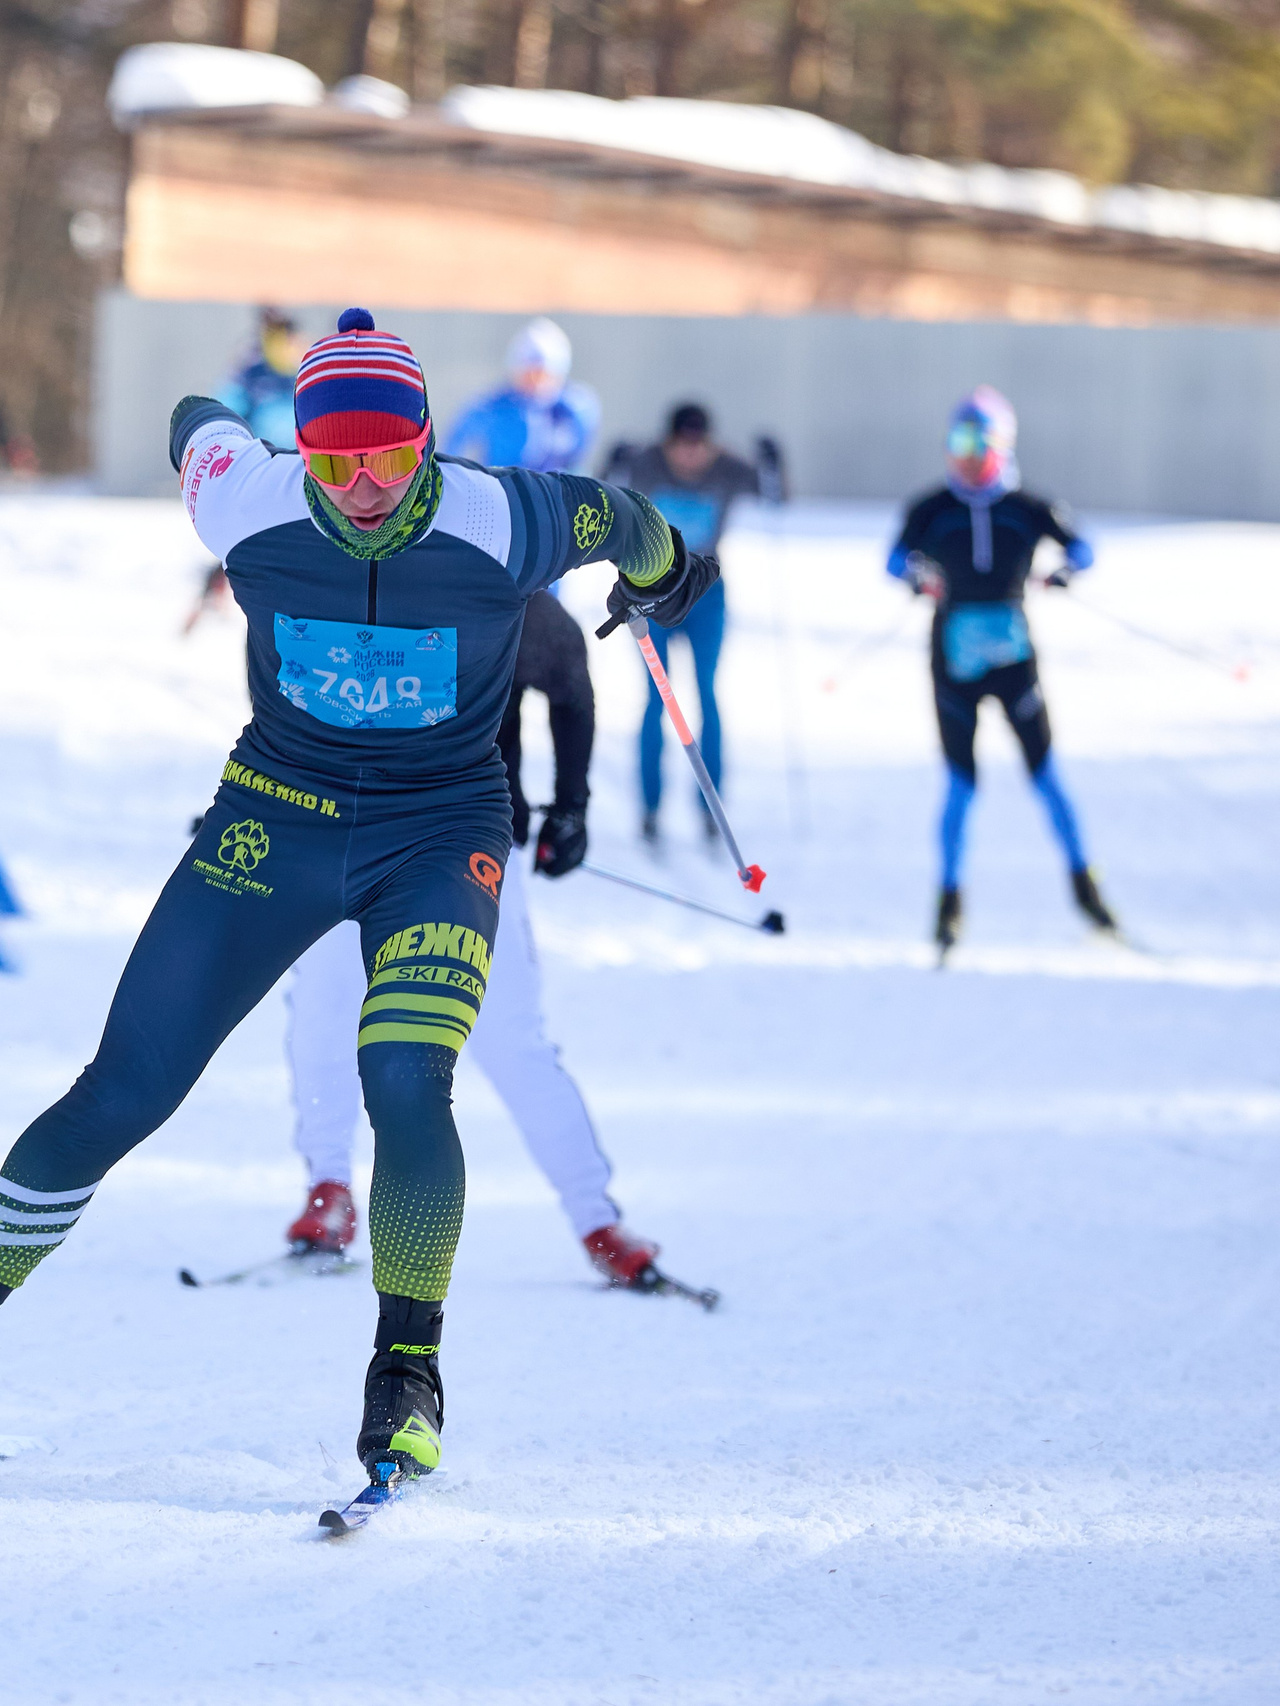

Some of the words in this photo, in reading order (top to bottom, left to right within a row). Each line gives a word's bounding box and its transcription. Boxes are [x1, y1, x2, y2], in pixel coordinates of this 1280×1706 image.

[354, 650, 405, 661] ЛЫЖНЯ
[354, 658, 405, 672] РОССИИ
[312, 668, 422, 713] 7648
[396, 967, 439, 981] SKI
[445, 970, 485, 1001] RAC
